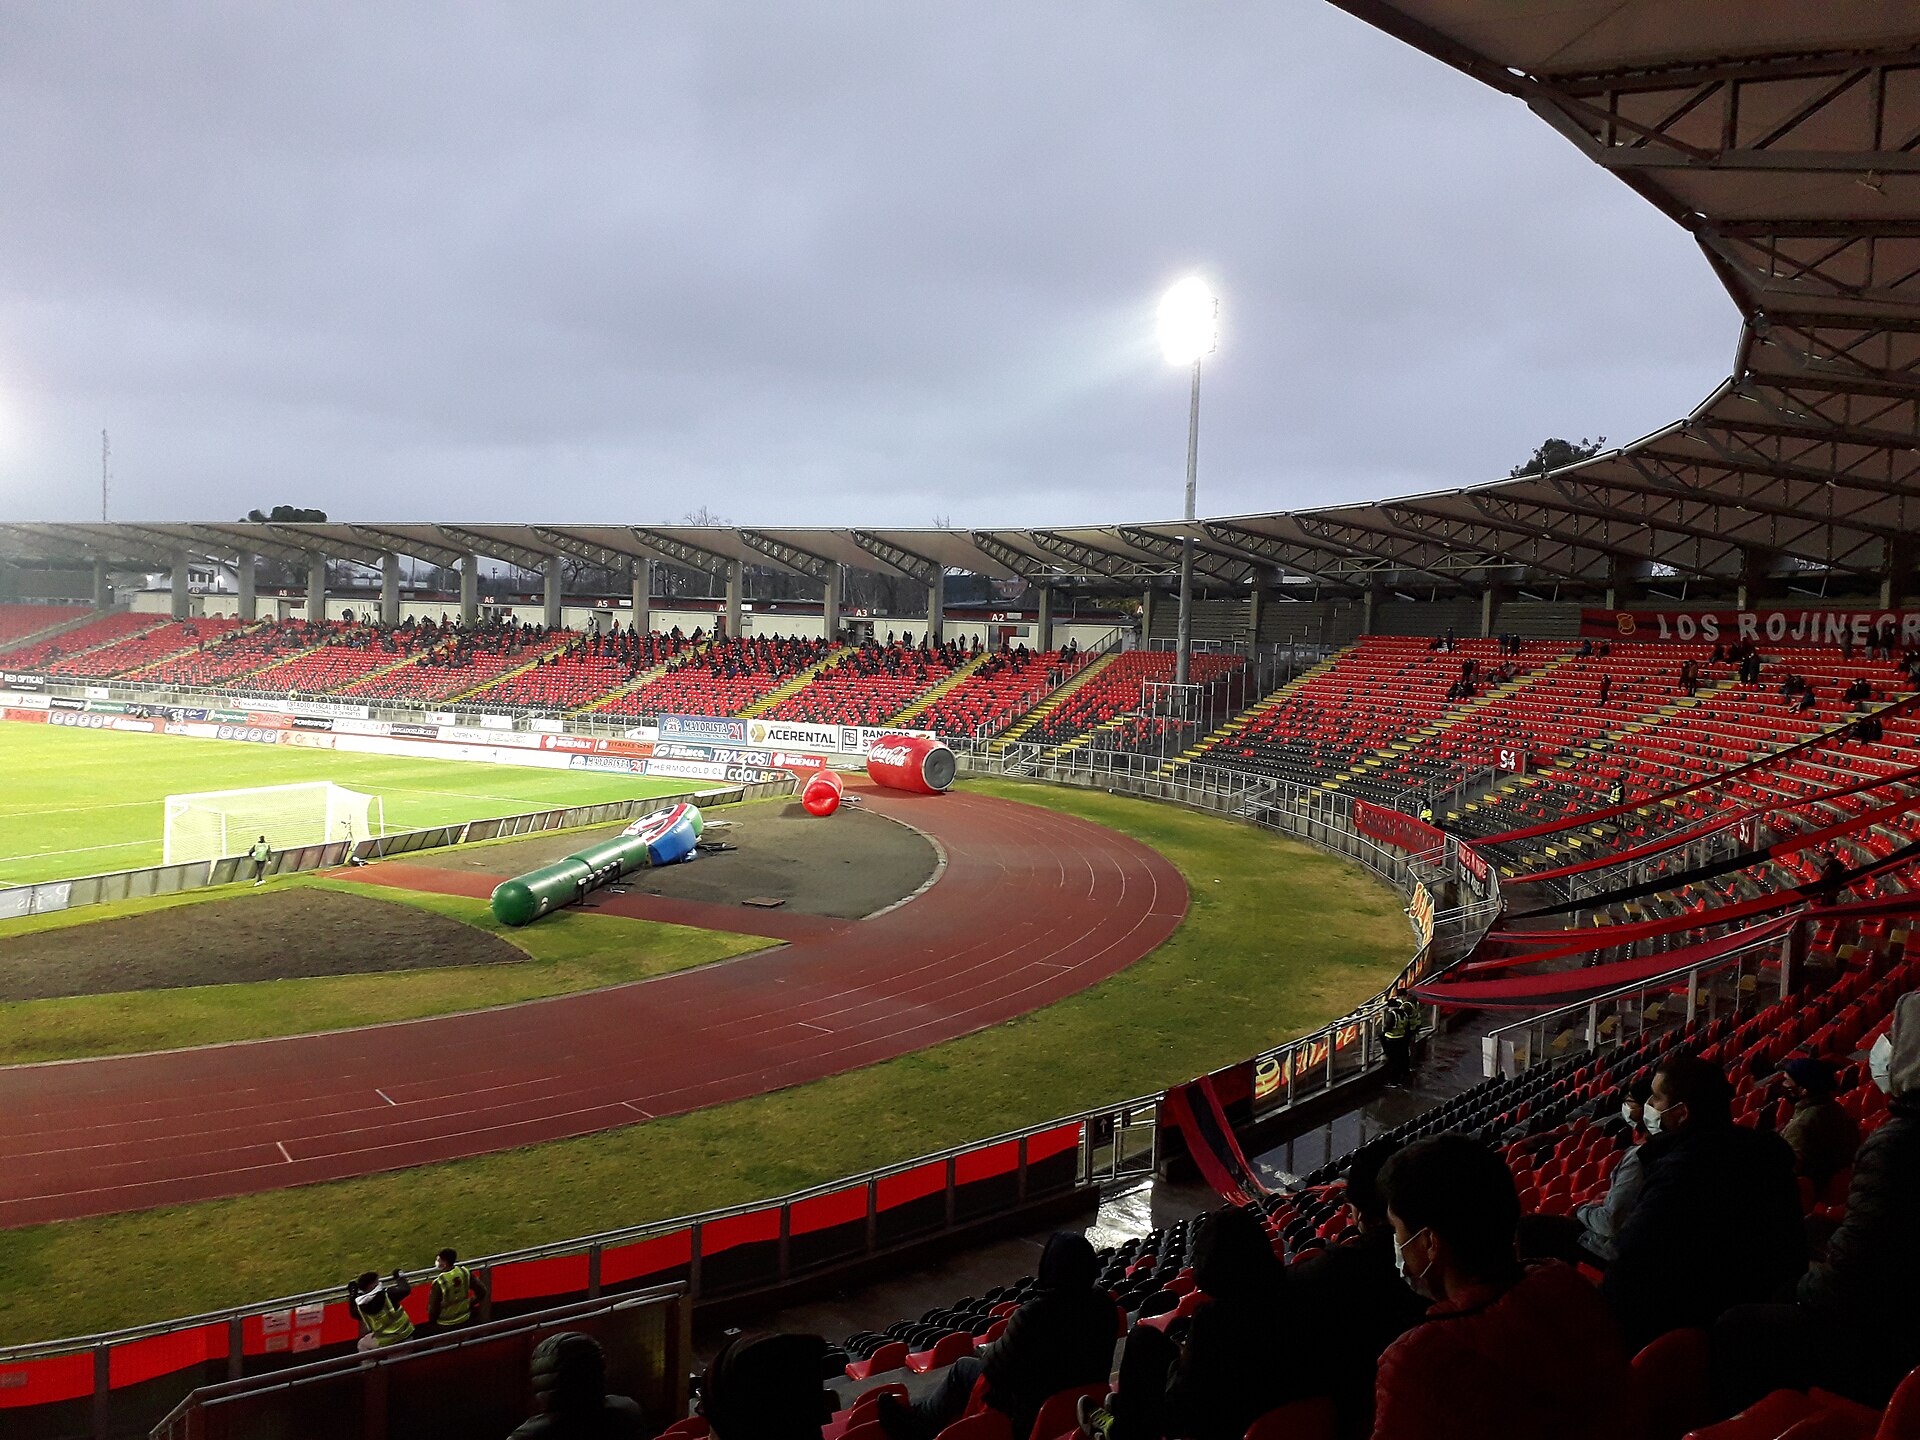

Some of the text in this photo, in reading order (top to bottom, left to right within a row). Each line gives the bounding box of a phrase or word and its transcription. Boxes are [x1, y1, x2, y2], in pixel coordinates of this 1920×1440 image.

[484, 596, 495, 604] A6
[597, 600, 608, 608] A5
[856, 609, 868, 617] A3
[991, 613, 1005, 622] A2
[1656, 613, 1720, 642] LOS
[4, 674, 44, 685] RED OPTICAS
[286, 700, 311, 708] ESTADIO
[312, 702, 332, 711] FISCAL
[684, 719, 728, 733] MAYORISTA
[728, 722, 743, 740] 21
[767, 729, 836, 744] ACERENTAL
[1499, 749, 1516, 770] S4
[630, 760, 645, 773] 21
[727, 766, 785, 782] COOLBET
